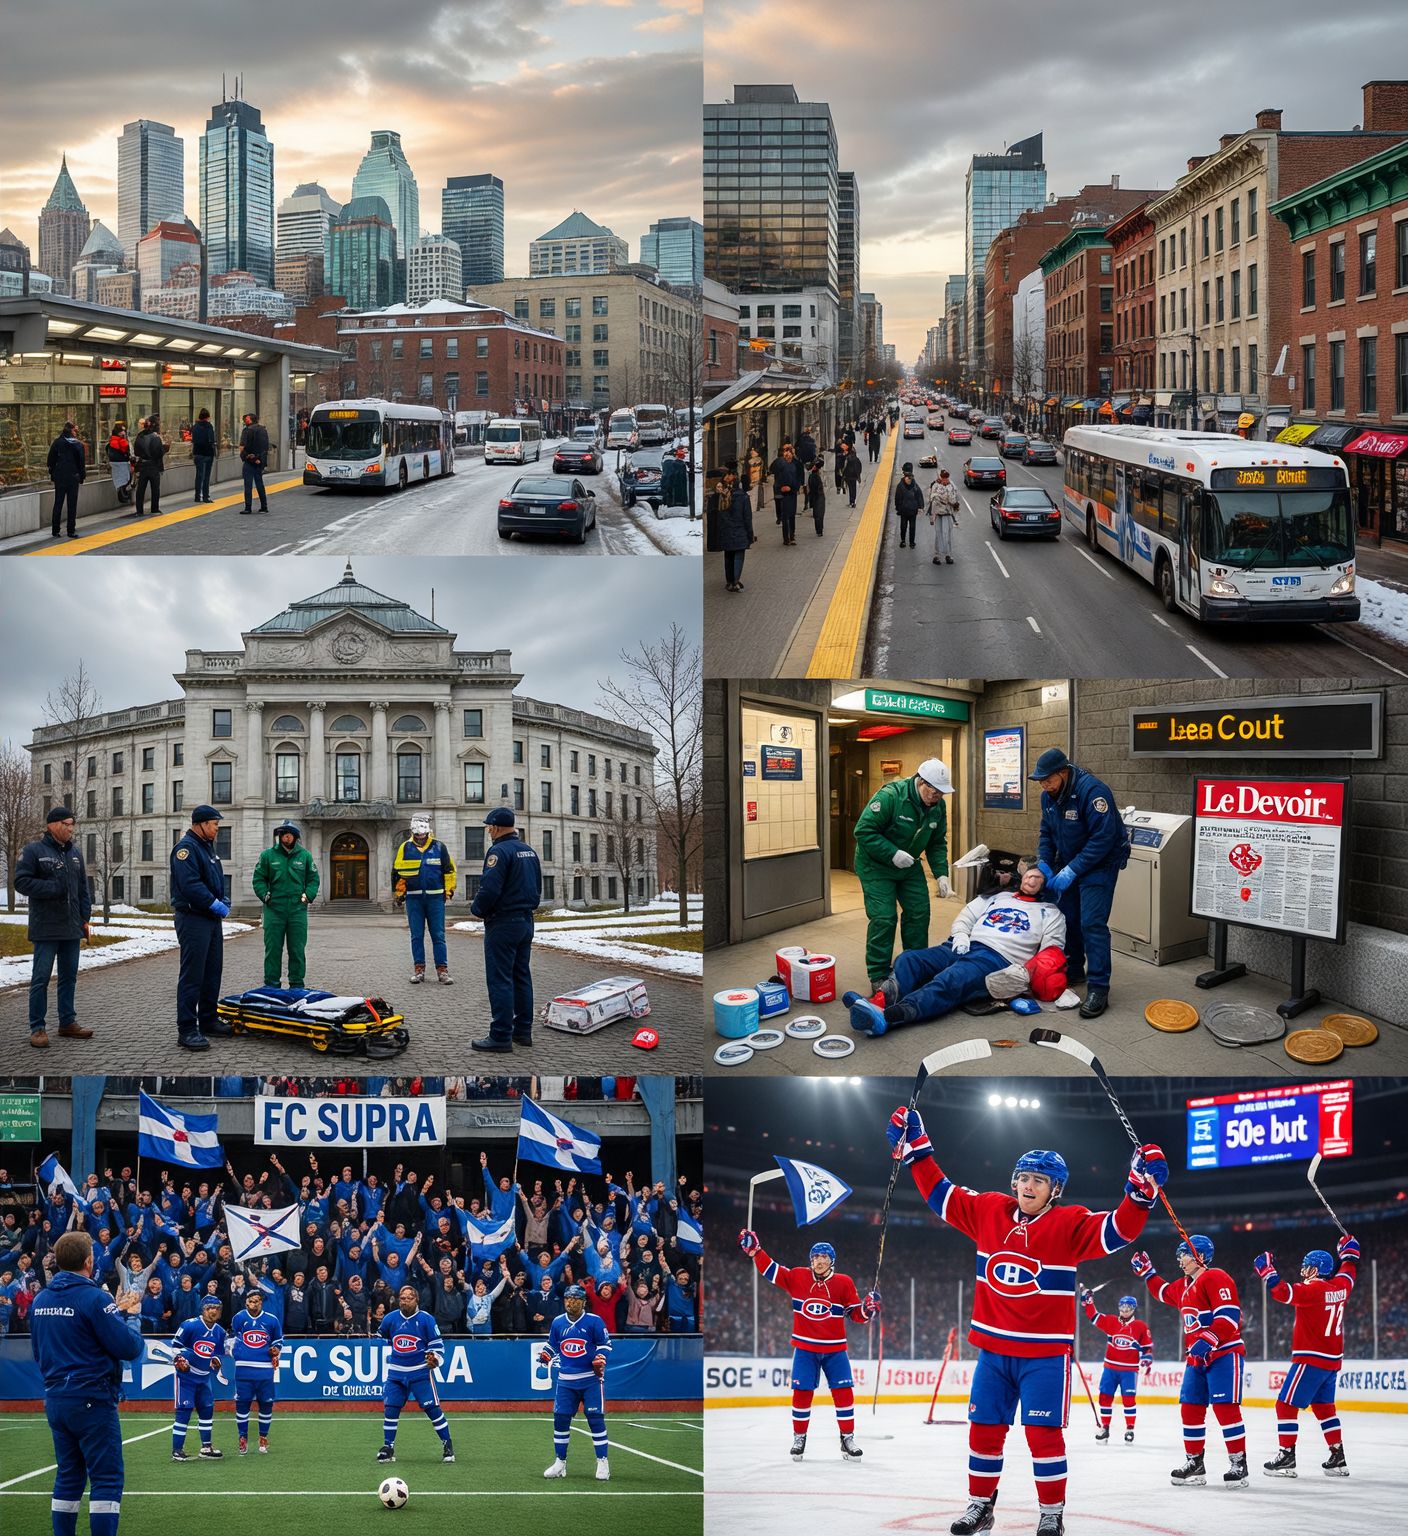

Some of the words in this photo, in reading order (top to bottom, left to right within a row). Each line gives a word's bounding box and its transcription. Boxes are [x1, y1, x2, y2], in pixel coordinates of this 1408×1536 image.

[1203, 784, 1234, 813] Le
[1236, 786, 1327, 818] Devoir
[263, 1101, 308, 1142] FC
[317, 1102, 438, 1143] SUPRA
[1225, 1118, 1266, 1149] 50e
[1270, 1114, 1308, 1145] but
[273, 1345, 318, 1383] FC
[328, 1345, 474, 1384] SUA
